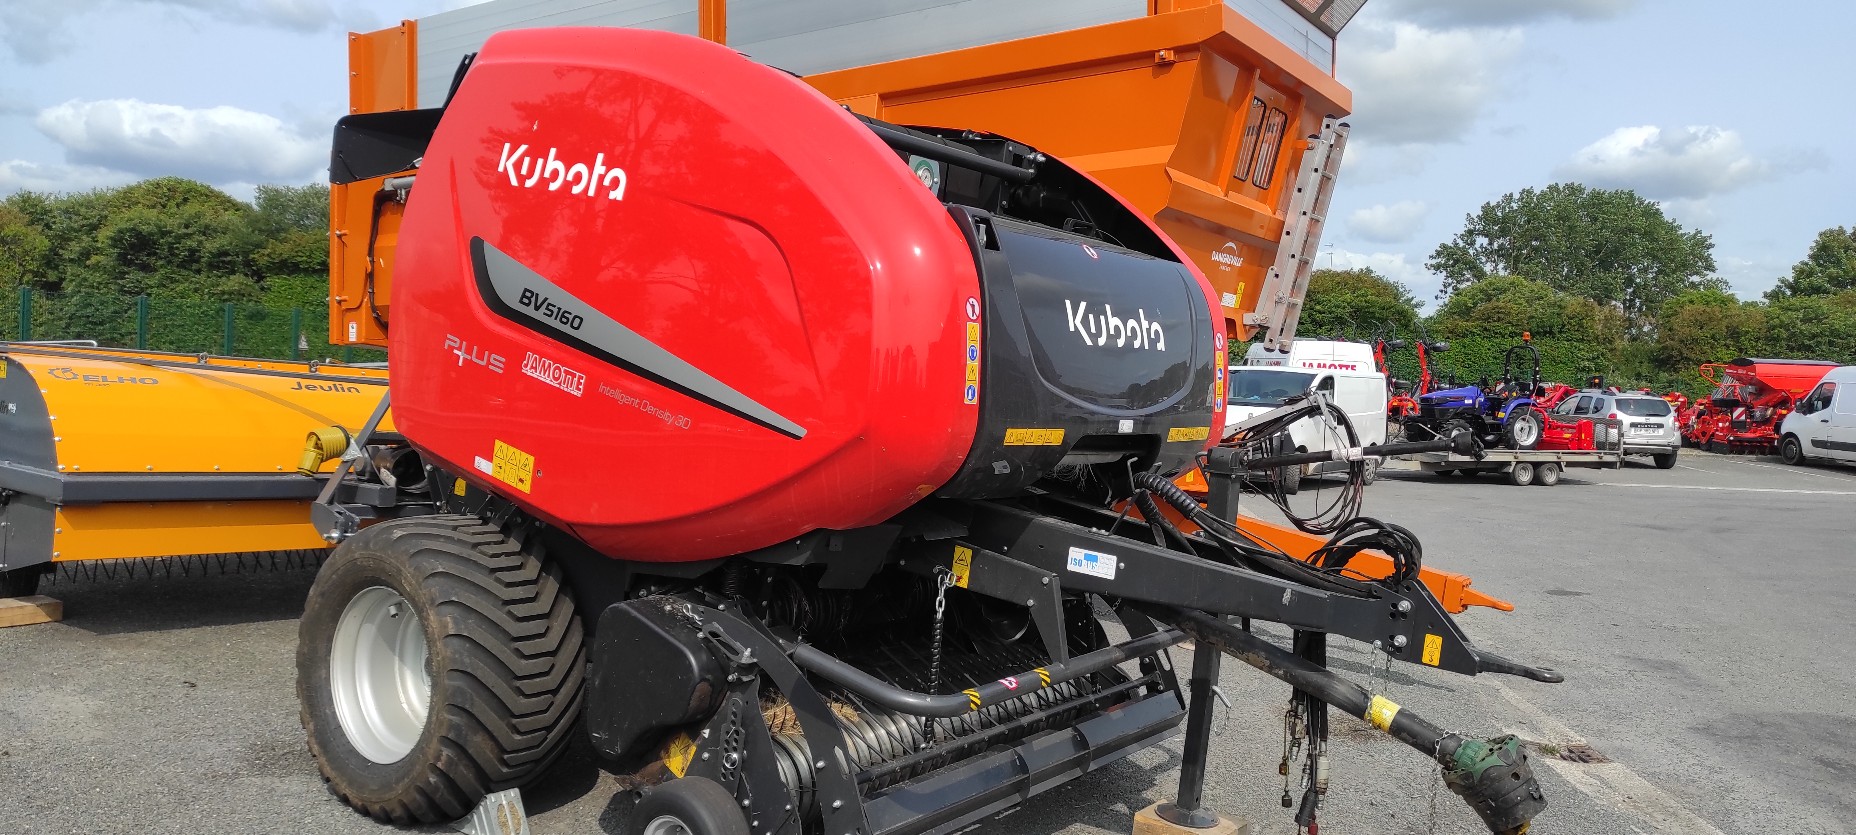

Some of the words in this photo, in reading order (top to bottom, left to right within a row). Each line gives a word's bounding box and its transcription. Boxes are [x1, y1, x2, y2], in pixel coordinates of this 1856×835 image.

[497, 142, 627, 201] Kubota
[518, 287, 584, 331] BV5160
[1065, 299, 1166, 351] Kubota
[444, 333, 506, 374] PLUS
[521, 351, 586, 394] JAMOTTE
[82, 374, 159, 385] ELHO
[290, 381, 361, 394] Jeulin
[598, 382, 641, 408] Intelligent
[639, 399, 675, 425] Density
[674, 414, 691, 430] 3D
